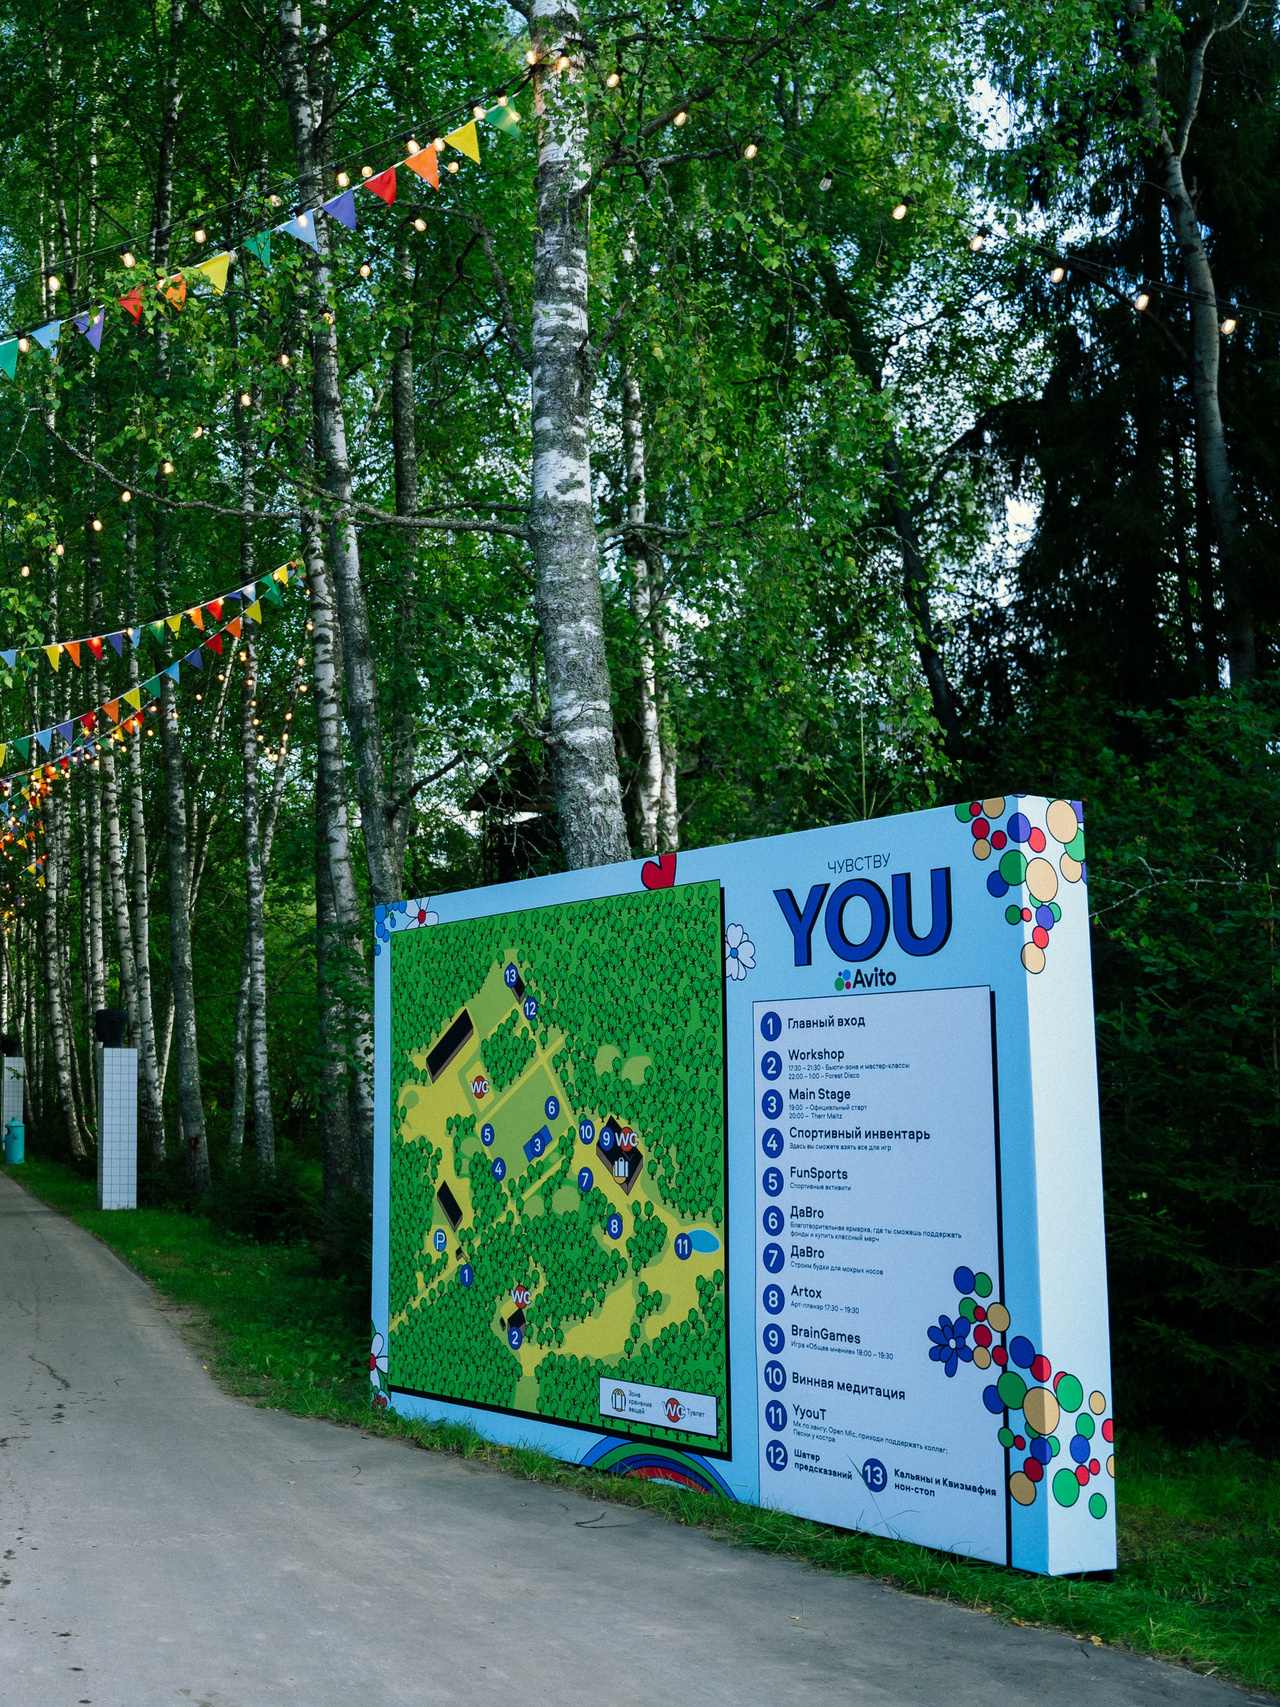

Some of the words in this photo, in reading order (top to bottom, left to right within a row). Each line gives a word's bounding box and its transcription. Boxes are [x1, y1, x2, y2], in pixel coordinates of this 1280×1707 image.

[828, 853, 890, 874] ЧУВСТВУ
[773, 867, 952, 967] YOU
[505, 969, 516, 982] 13
[853, 967, 896, 988] Avito
[525, 1002, 536, 1016] 12
[767, 1018, 773, 1035] 1
[788, 1015, 834, 1029] Главный
[838, 1016, 865, 1027] вход
[767, 1057, 776, 1074] 2
[788, 1049, 844, 1062] Workshop
[470, 1080, 489, 1094] WC
[548, 1101, 555, 1114] 6
[767, 1096, 777, 1113] 3
[789, 1088, 815, 1100] Main
[818, 1088, 850, 1102] Stage
[484, 1128, 491, 1141] 5
[580, 1125, 592, 1139] 10
[603, 1132, 610, 1145] 9
[615, 1131, 639, 1147] WC
[767, 1134, 777, 1151] 4
[789, 1126, 862, 1141] Спортивный
[865, 1128, 930, 1142] инвентарь
[534, 1139, 541, 1151] 3
[495, 1163, 502, 1175] 4
[582, 1173, 589, 1186] 7
[768, 1173, 777, 1191] 5
[790, 1166, 848, 1181] FunSports
[768, 1212, 778, 1229] 6
[790, 1205, 824, 1219] ДаBro
[611, 1219, 618, 1233] 8
[436, 1232, 445, 1250] P
[677, 1240, 688, 1254] 11
[769, 1249, 778, 1267] 7
[791, 1245, 824, 1259] ДаBro
[464, 1269, 468, 1282] 1
[511, 1290, 531, 1305] WC
[768, 1290, 778, 1308] 8
[791, 1285, 822, 1299] Artox
[512, 1331, 518, 1344] 2
[769, 1330, 778, 1348] 9
[791, 1325, 860, 1344] BrainGames
[856, 1349, 871, 1357] 18:00
[878, 1352, 893, 1360] 19:30
[766, 1367, 783, 1385] 10
[792, 1372, 834, 1389] Винная
[837, 1382, 905, 1400] медитация
[662, 1401, 686, 1419] WC
[769, 1406, 783, 1426] 11
[792, 1404, 826, 1421] YyouT
[829, 1427, 844, 1435] Open
[768, 1446, 785, 1465] 12
[794, 1449, 820, 1462] Шатер
[794, 1462, 852, 1480] предсказаний
[865, 1465, 884, 1485] 13
[894, 1468, 933, 1485] Кальяны
[934, 1477, 940, 1486] и
[942, 1478, 997, 1497] Квизмафия
[894, 1482, 935, 1497] нон-стоп
